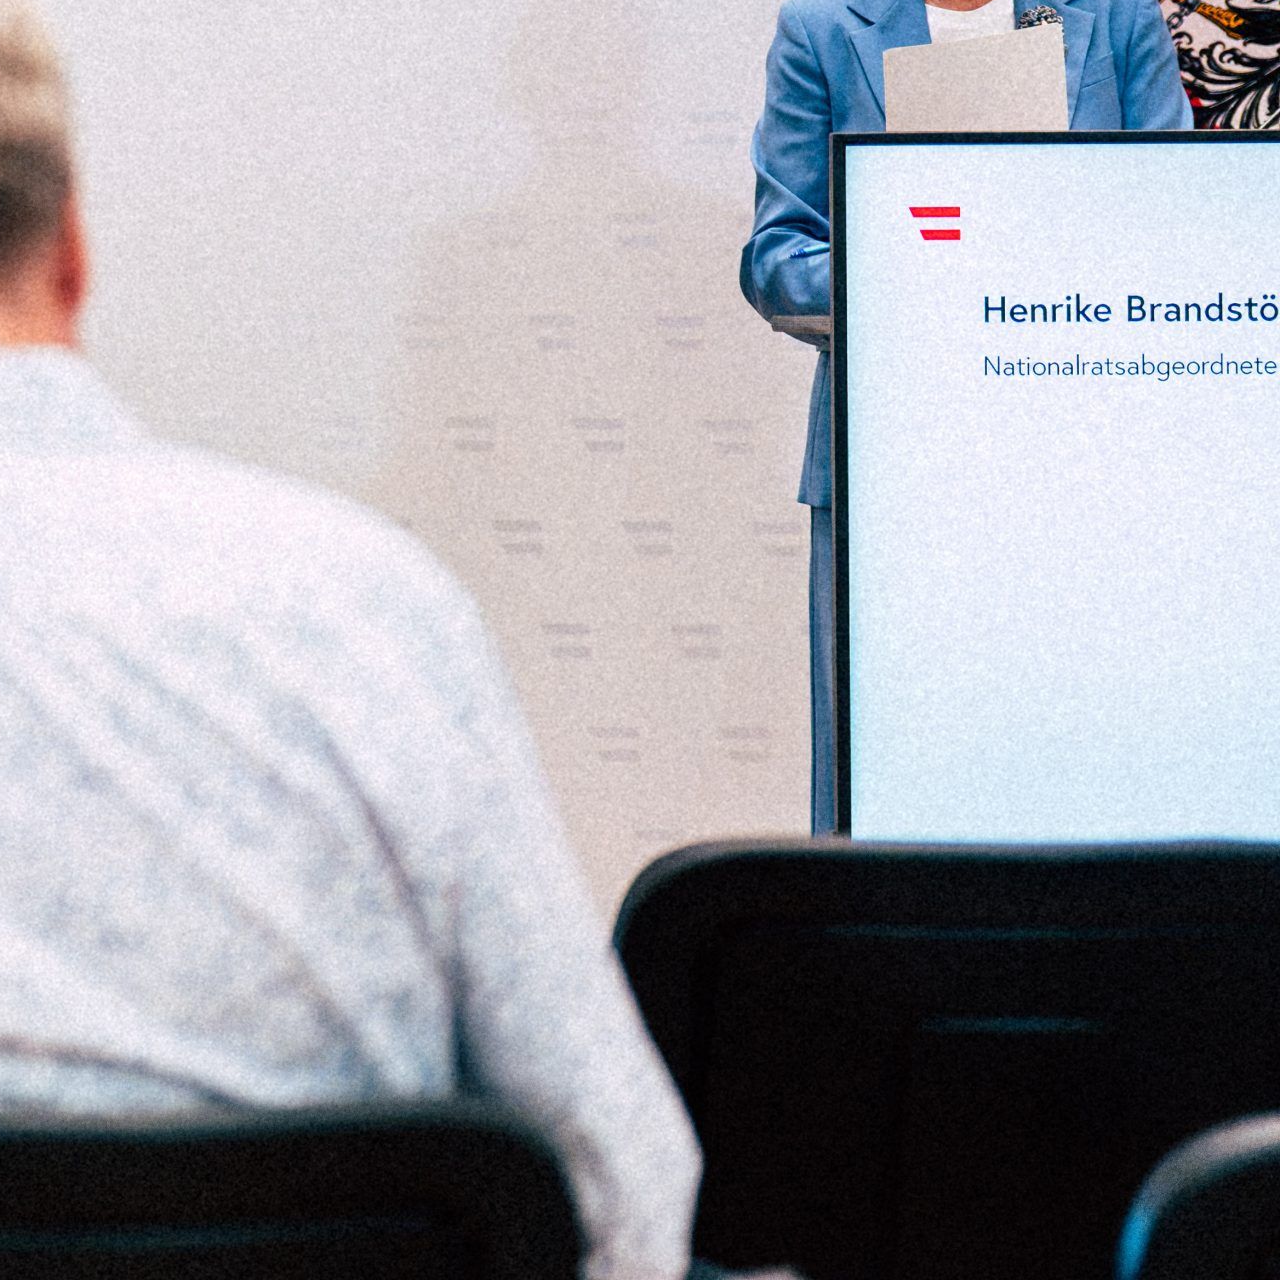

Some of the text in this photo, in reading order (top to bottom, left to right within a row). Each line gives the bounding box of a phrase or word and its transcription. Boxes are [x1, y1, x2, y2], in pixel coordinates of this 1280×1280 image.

[983, 292, 1279, 324] Henrike Brandstö
[983, 352, 1279, 382] Nationalratsabgeordnete
